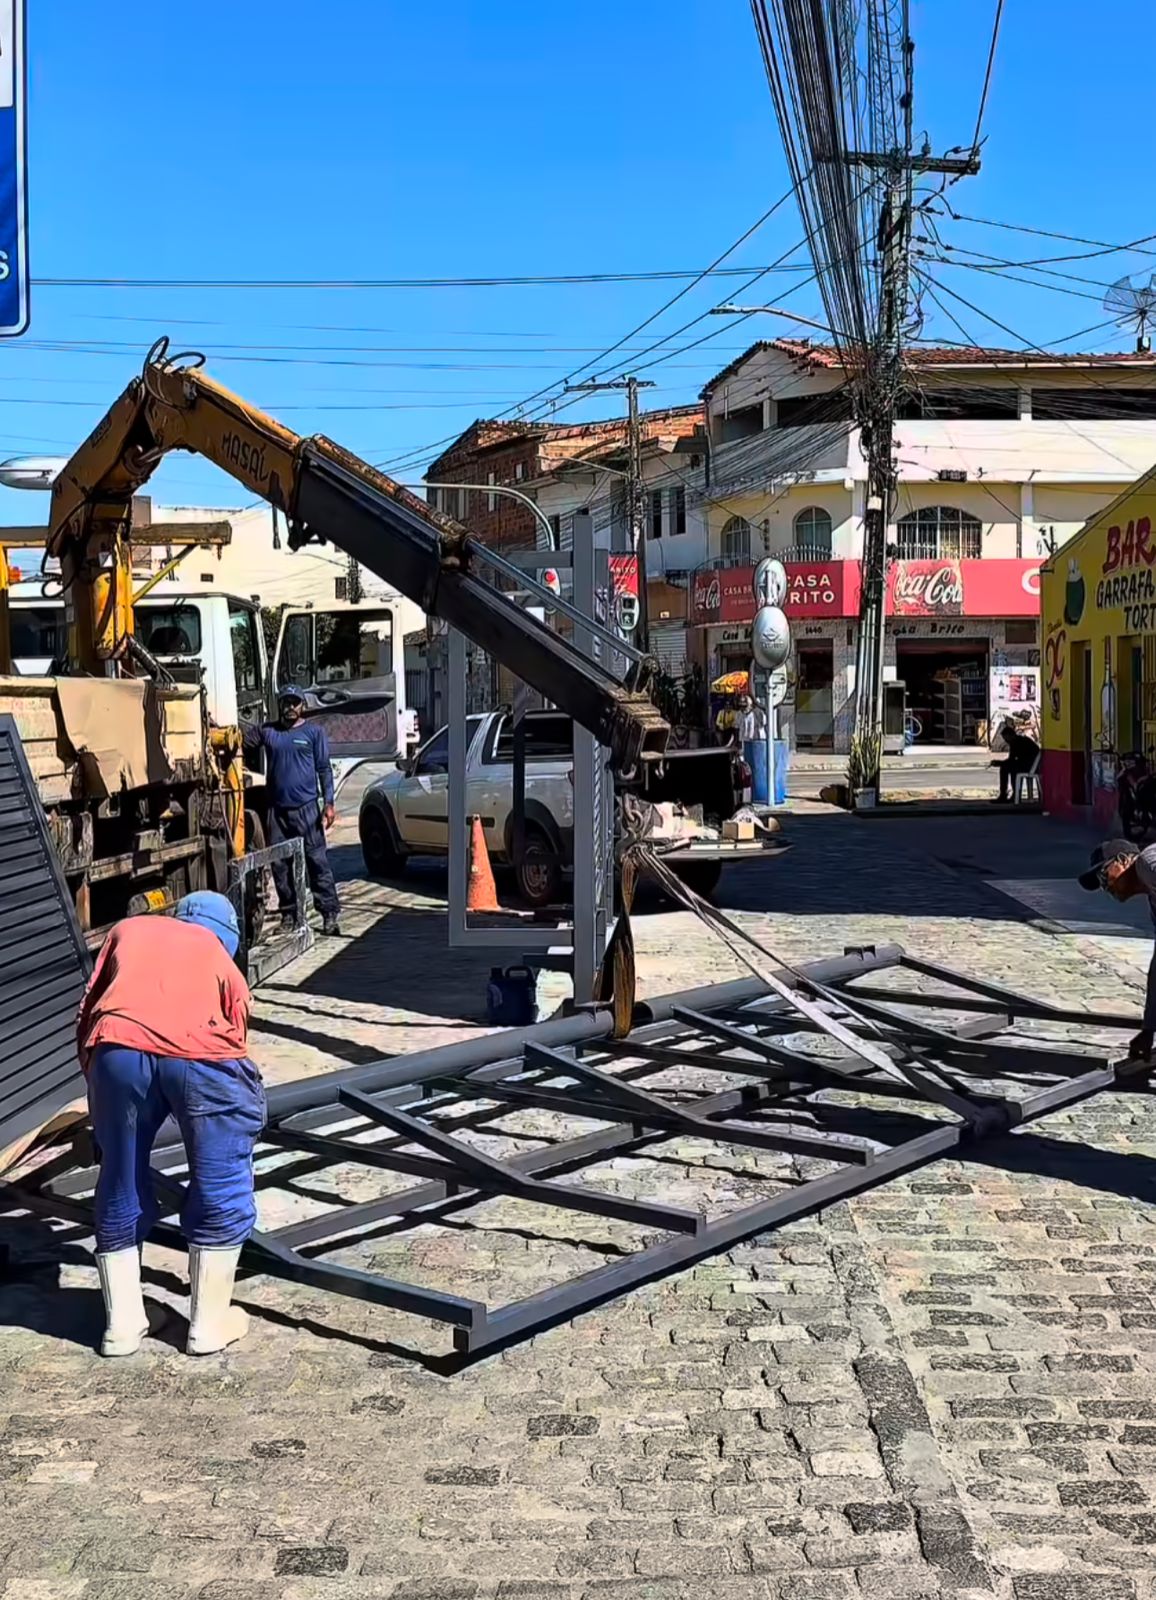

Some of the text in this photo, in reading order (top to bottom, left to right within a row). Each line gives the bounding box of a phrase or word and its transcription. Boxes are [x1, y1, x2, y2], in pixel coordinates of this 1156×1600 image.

[1103, 516, 1156, 574] BAR
[787, 573, 832, 588] ASA
[723, 585, 742, 597] CASA
[1096, 568, 1155, 609] GARRAFA
[785, 590, 835, 605] RITO
